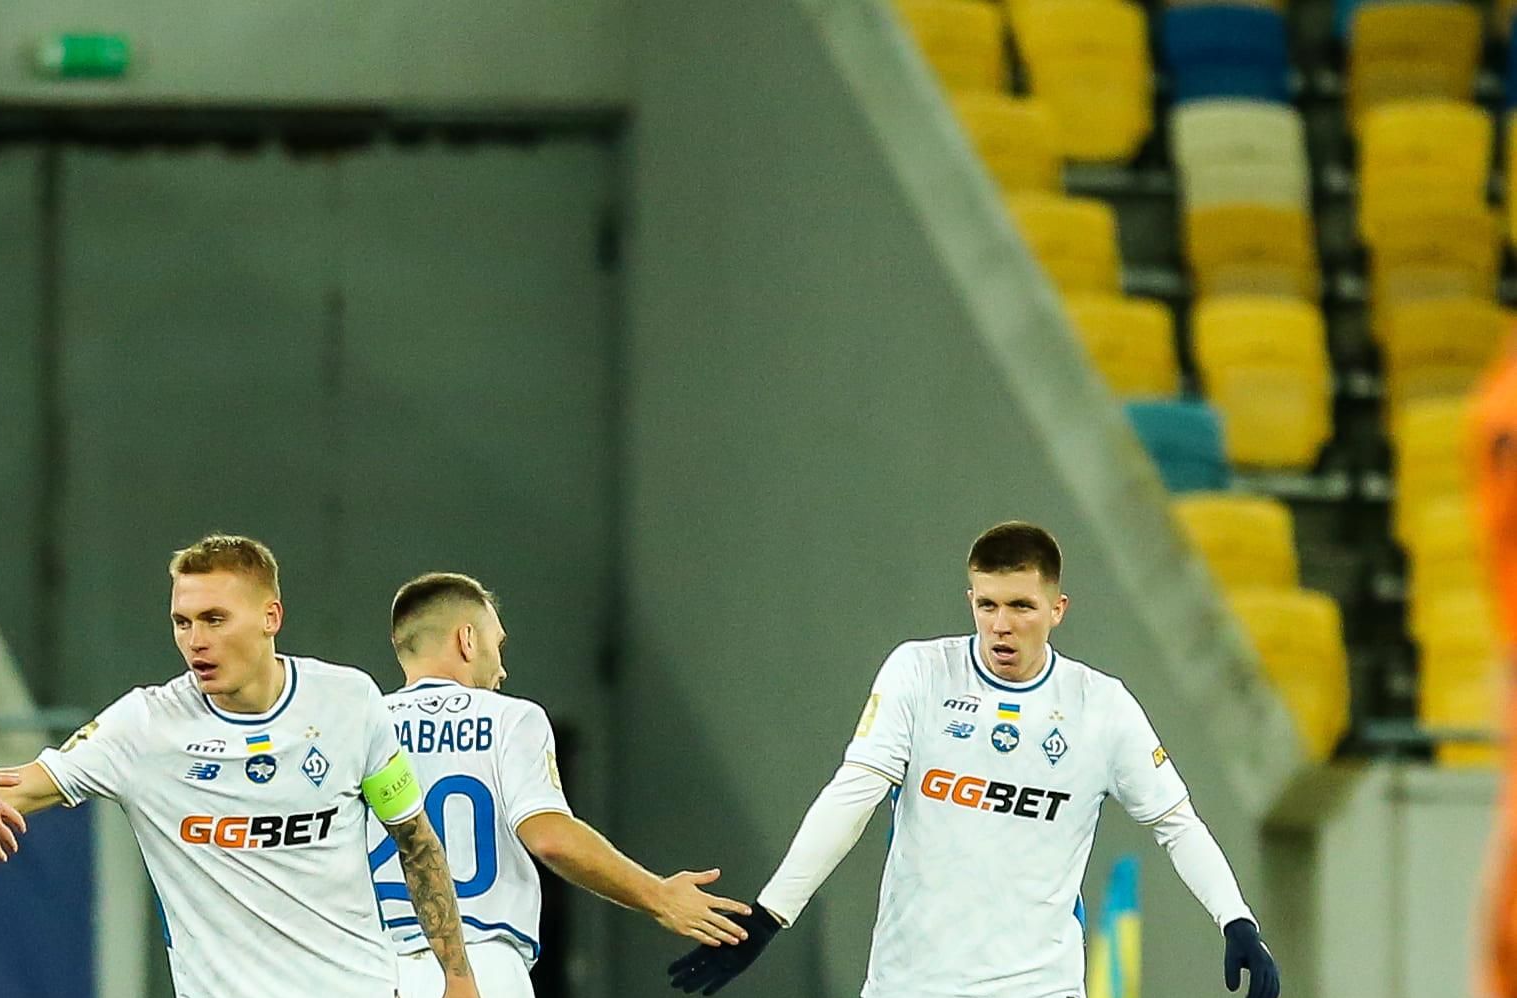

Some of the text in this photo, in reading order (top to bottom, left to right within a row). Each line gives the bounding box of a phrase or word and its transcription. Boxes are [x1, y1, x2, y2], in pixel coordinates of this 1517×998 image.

[394, 717, 493, 753] АВАЄВ
[920, 768, 1073, 822] GG.BET
[180, 806, 339, 848] GG.BET
